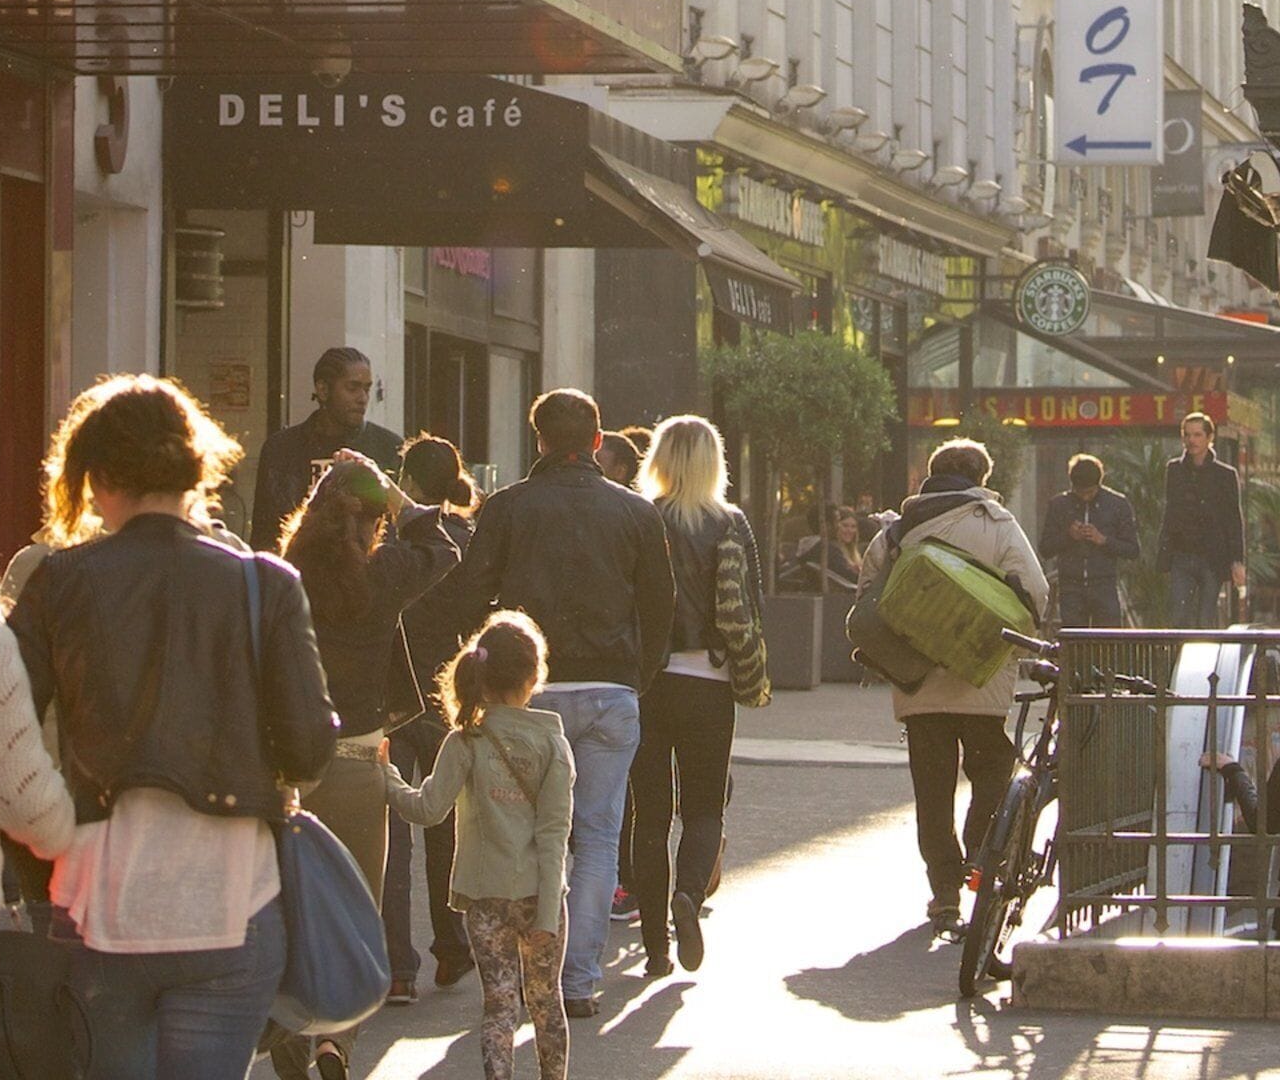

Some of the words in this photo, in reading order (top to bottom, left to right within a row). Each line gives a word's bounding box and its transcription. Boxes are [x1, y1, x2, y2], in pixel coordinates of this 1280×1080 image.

[220, 93, 407, 128] DELI'S
[430, 96, 522, 128] café
[1027, 270, 1084, 299] STARBUCKS
[1031, 313, 1076, 331] COFFEE
[1099, 395, 1132, 420] DE
